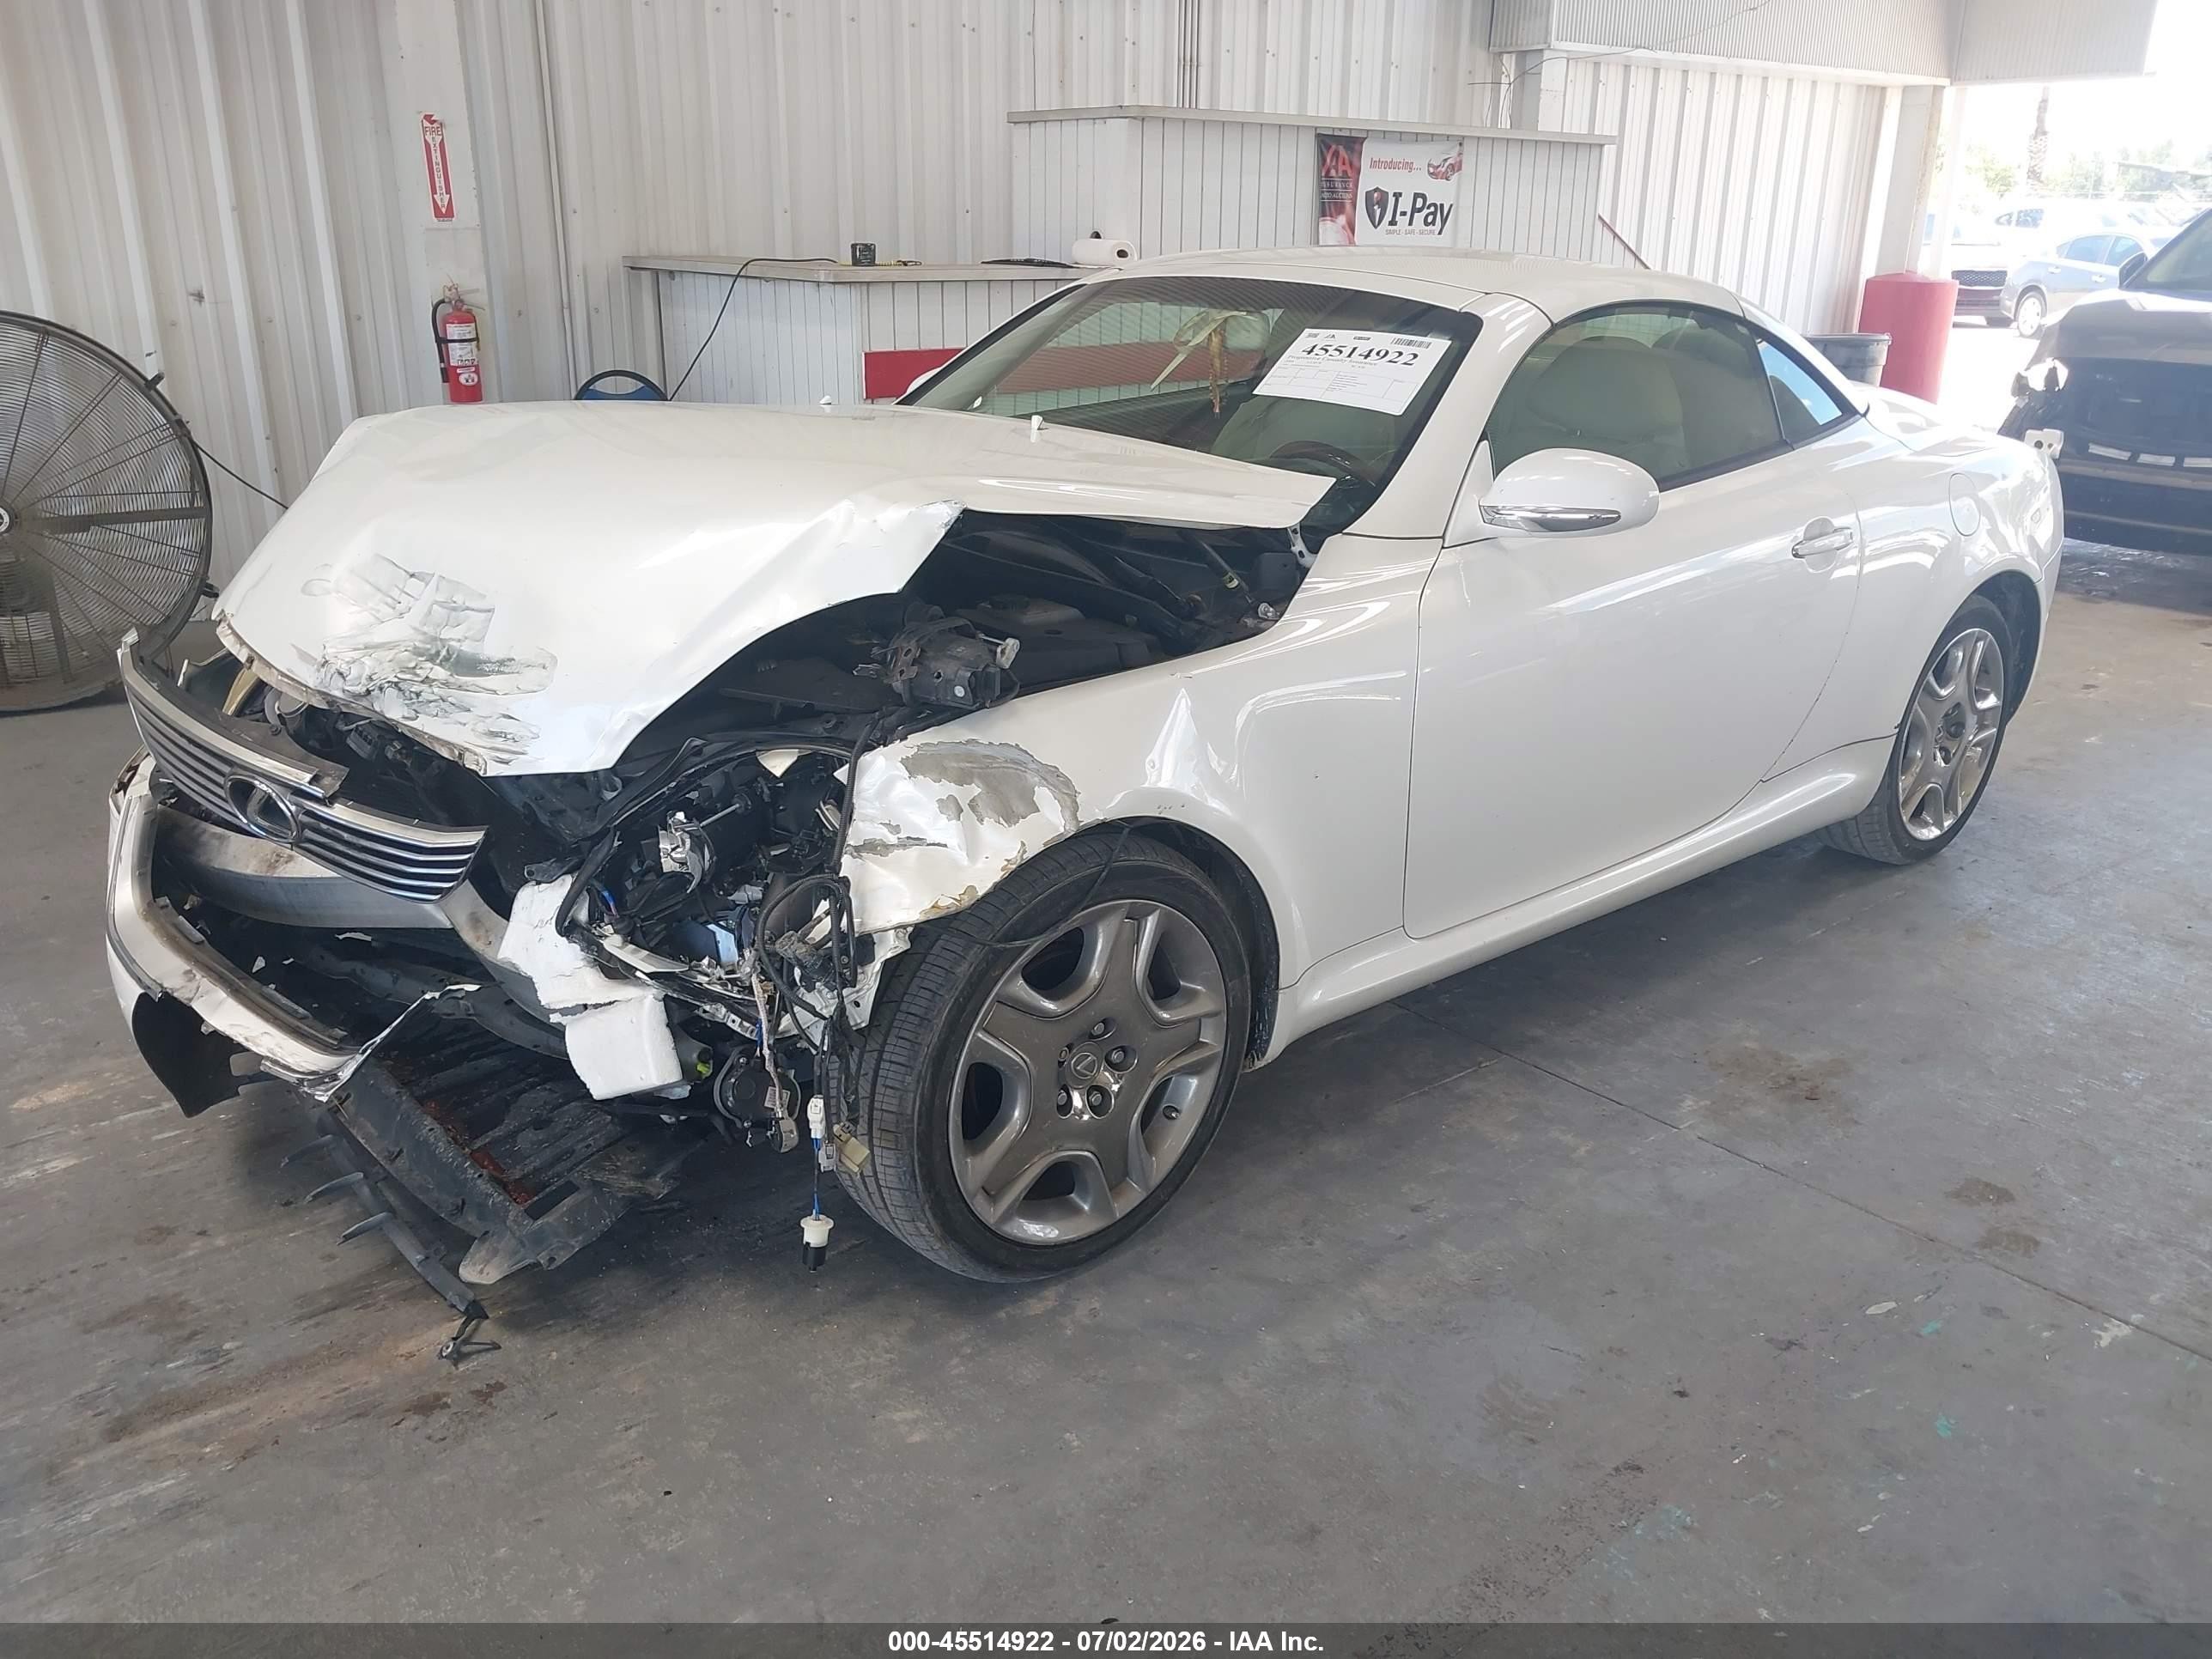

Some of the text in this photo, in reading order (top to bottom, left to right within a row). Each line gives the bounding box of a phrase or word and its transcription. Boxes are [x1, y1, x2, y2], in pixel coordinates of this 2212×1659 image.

[424, 126, 441, 136] FIRE
[432, 137, 445, 208] EXTINGUISHER
[1370, 157, 1422, 173] Introducing...
[1388, 191, 1453, 235] I-Pay
[1302, 343, 1419, 366] 45514922
